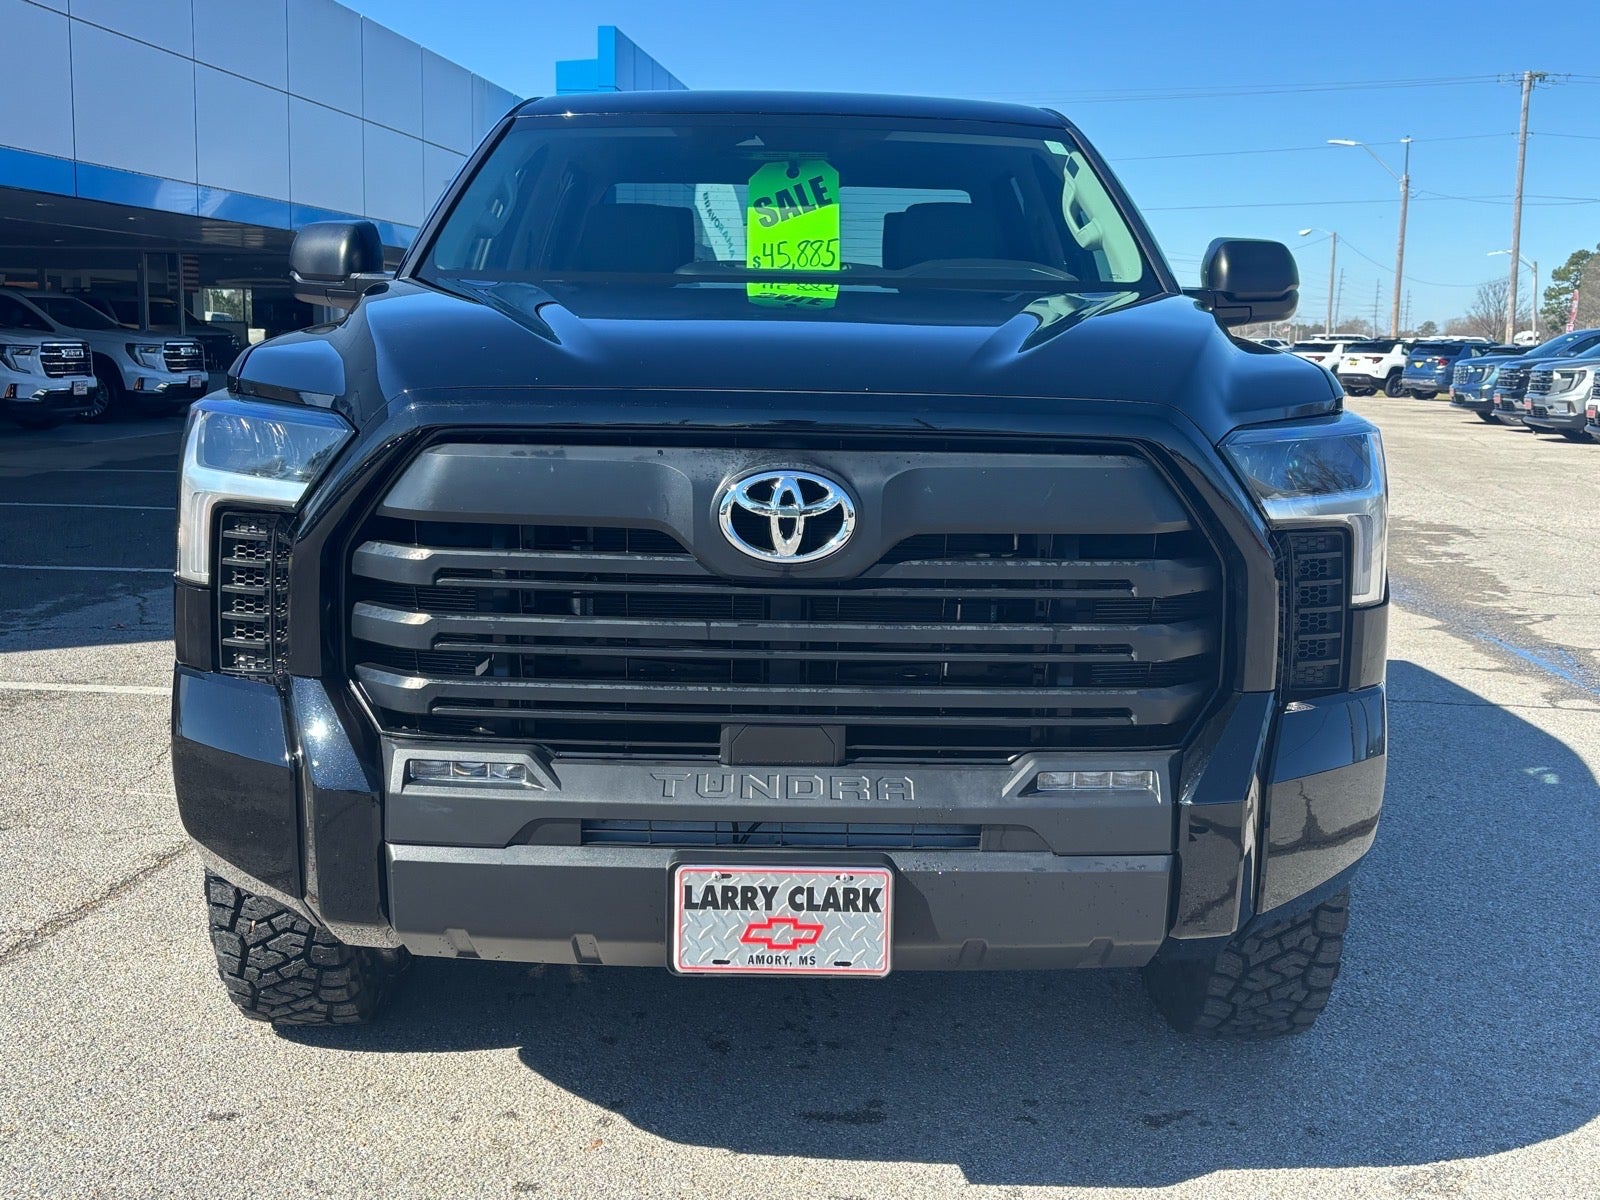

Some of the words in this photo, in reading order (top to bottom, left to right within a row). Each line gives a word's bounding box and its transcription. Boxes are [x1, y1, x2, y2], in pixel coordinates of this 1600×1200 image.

[753, 175, 833, 228] SALE
[752, 238, 839, 269] $45,885
[649, 773, 915, 801] TUNDRA
[684, 884, 778, 911] LARRY
[787, 885, 883, 913] CLARK
[747, 955, 793, 967] AMORY,
[798, 956, 816, 966] MS
